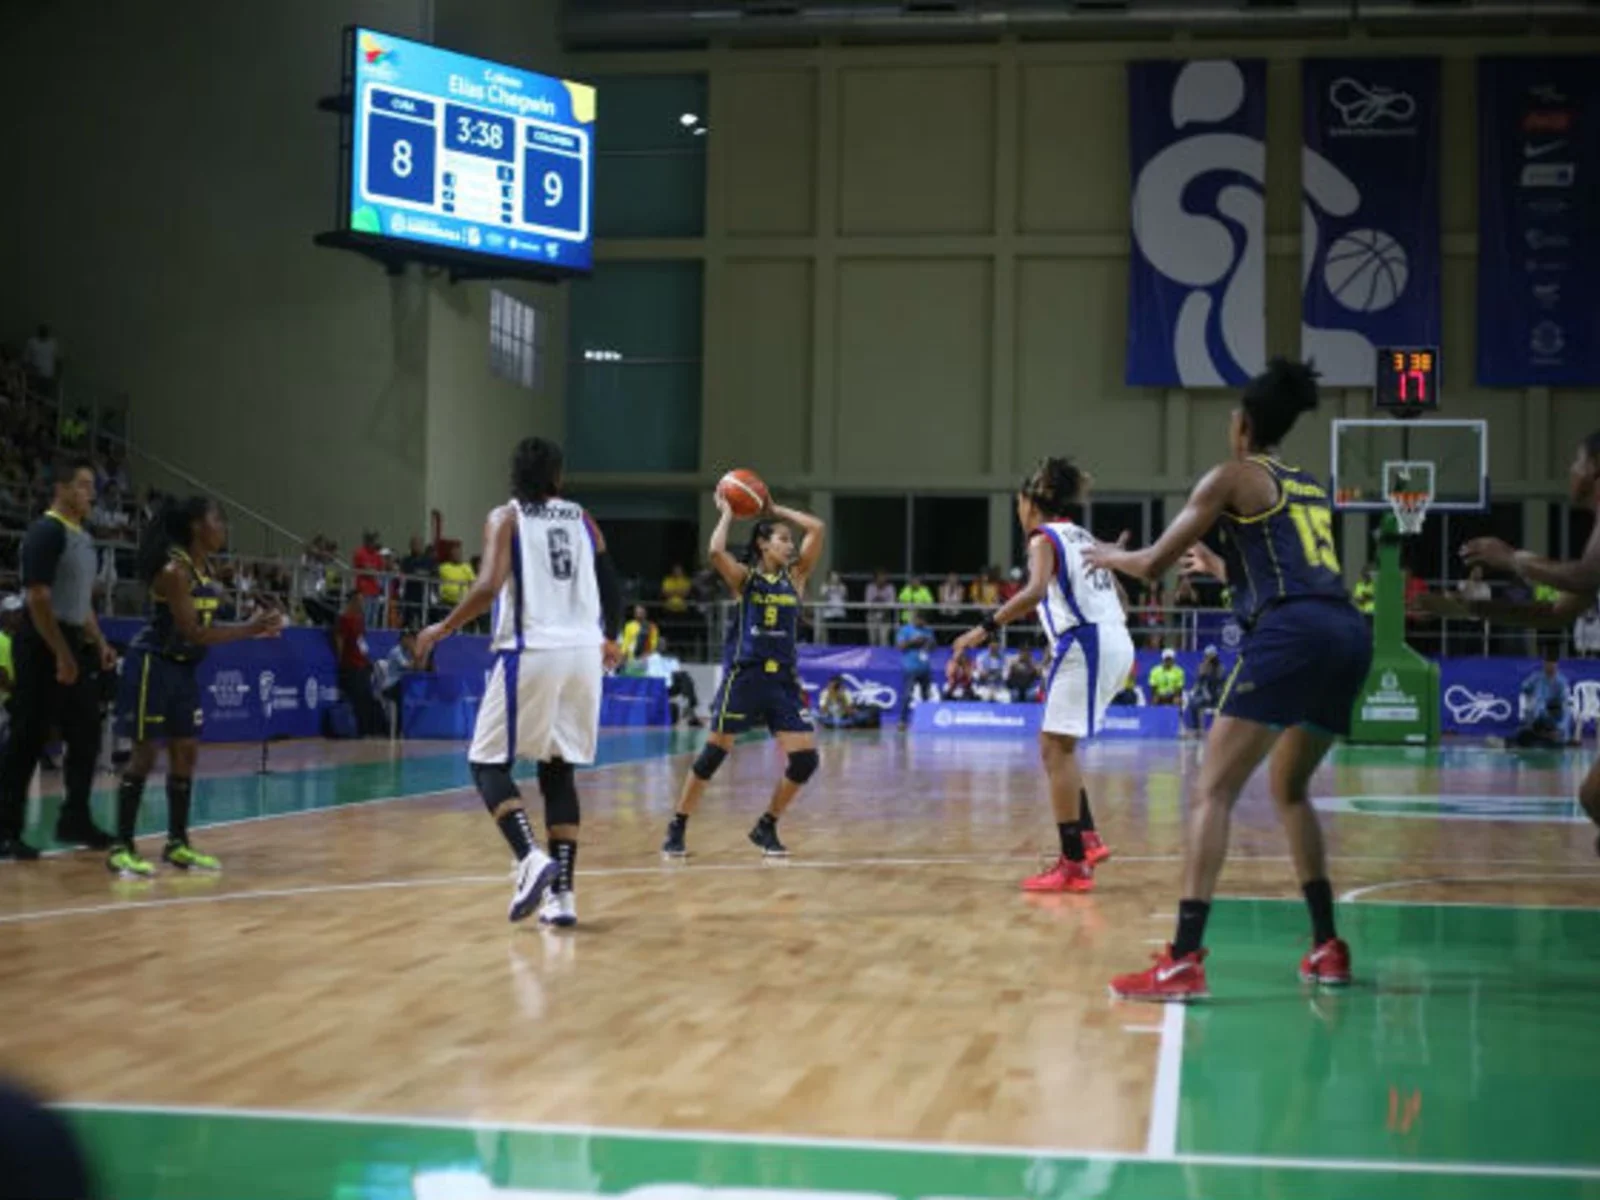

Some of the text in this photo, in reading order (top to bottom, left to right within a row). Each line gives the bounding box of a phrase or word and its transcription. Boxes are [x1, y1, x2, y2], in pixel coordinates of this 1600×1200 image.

[456, 115, 504, 149] 3:38
[391, 139, 413, 178] 8
[542, 171, 563, 207] 9
[1398, 370, 1425, 403] 17
[546, 527, 572, 581] 6
[1288, 502, 1340, 575] 15
